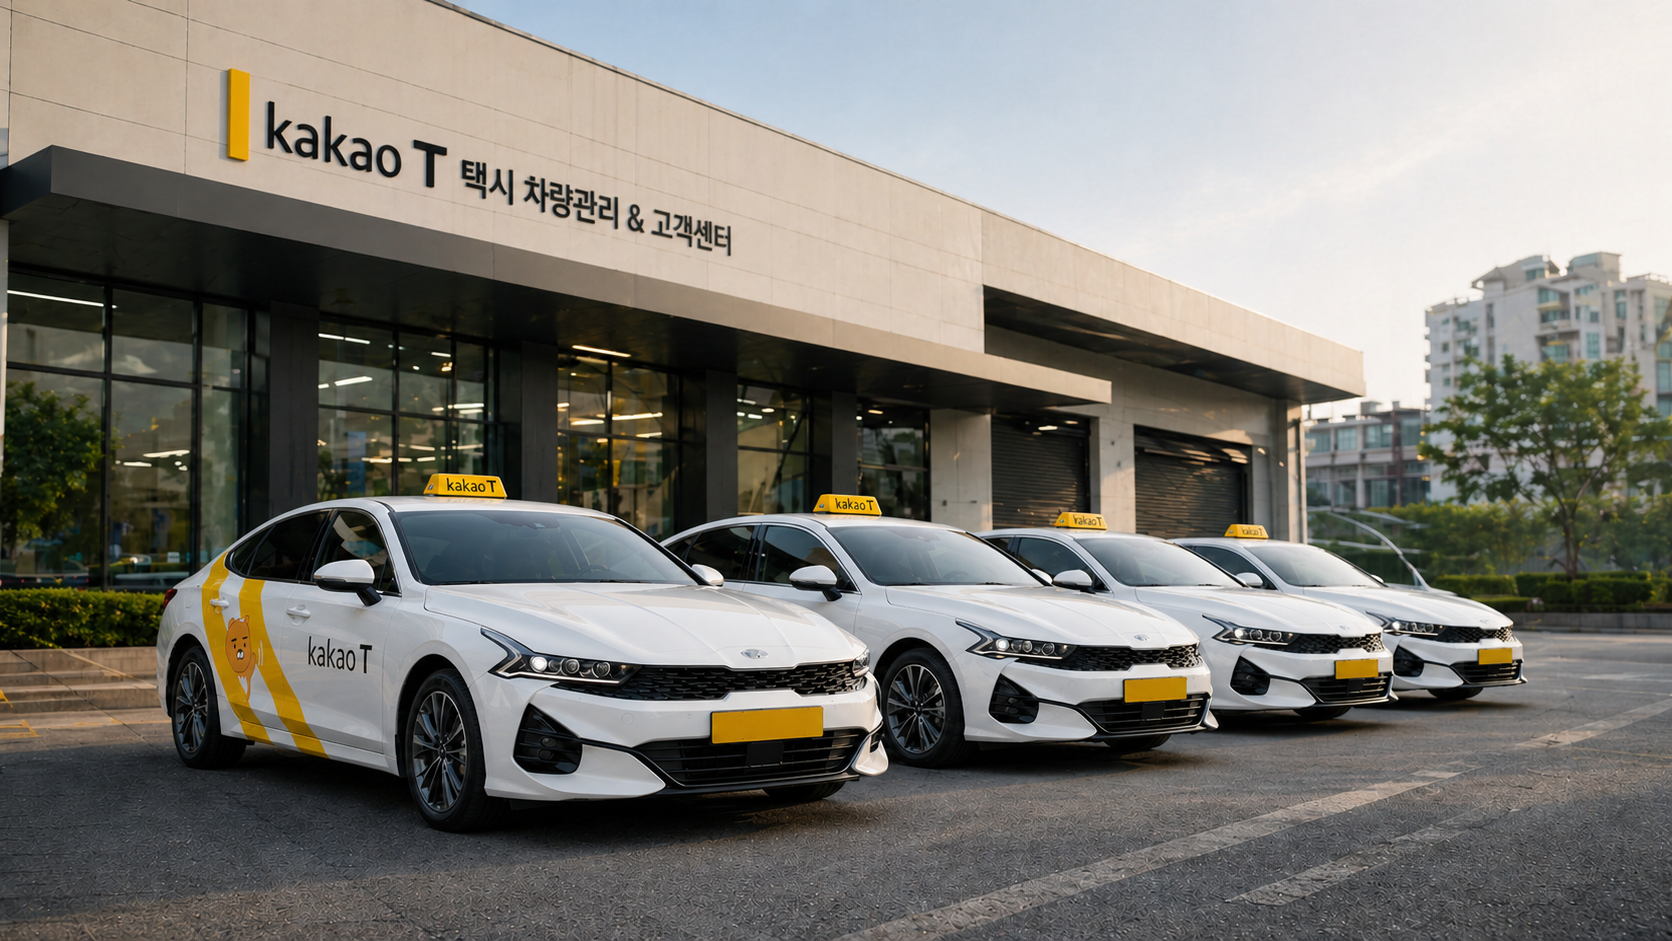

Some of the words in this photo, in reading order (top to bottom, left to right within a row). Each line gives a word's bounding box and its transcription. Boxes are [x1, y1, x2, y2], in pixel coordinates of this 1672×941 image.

[266, 100, 402, 178] kakao
[414, 139, 448, 188] T
[460, 159, 514, 206] 택시
[523, 175, 619, 230] 차량관리
[627, 204, 645, 234] &
[651, 208, 732, 257] 고객센터
[446, 477, 486, 493] kakao
[307, 635, 356, 672] kakao
[359, 643, 373, 674] T
